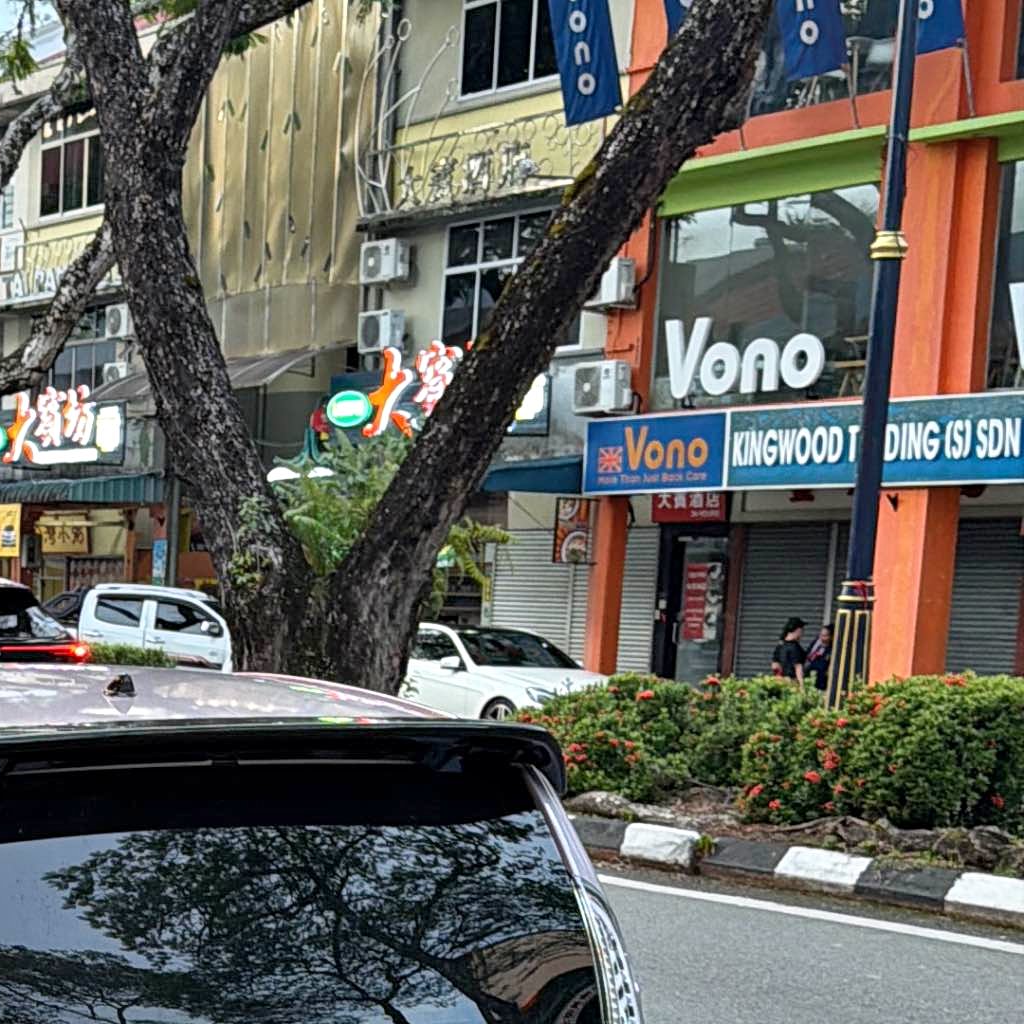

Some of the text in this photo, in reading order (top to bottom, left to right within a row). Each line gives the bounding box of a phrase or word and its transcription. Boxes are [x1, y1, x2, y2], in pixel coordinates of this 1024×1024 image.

[568, 0, 596, 96] ono
[665, 317, 825, 399] Vono
[625, 426, 708, 470] Vono
[732, 417, 1022, 467] KINGWOOD TDING (S) SDN
[621, 474, 641, 484] Than
[643, 473, 659, 483] Just
[686, 471, 707, 481] Care
